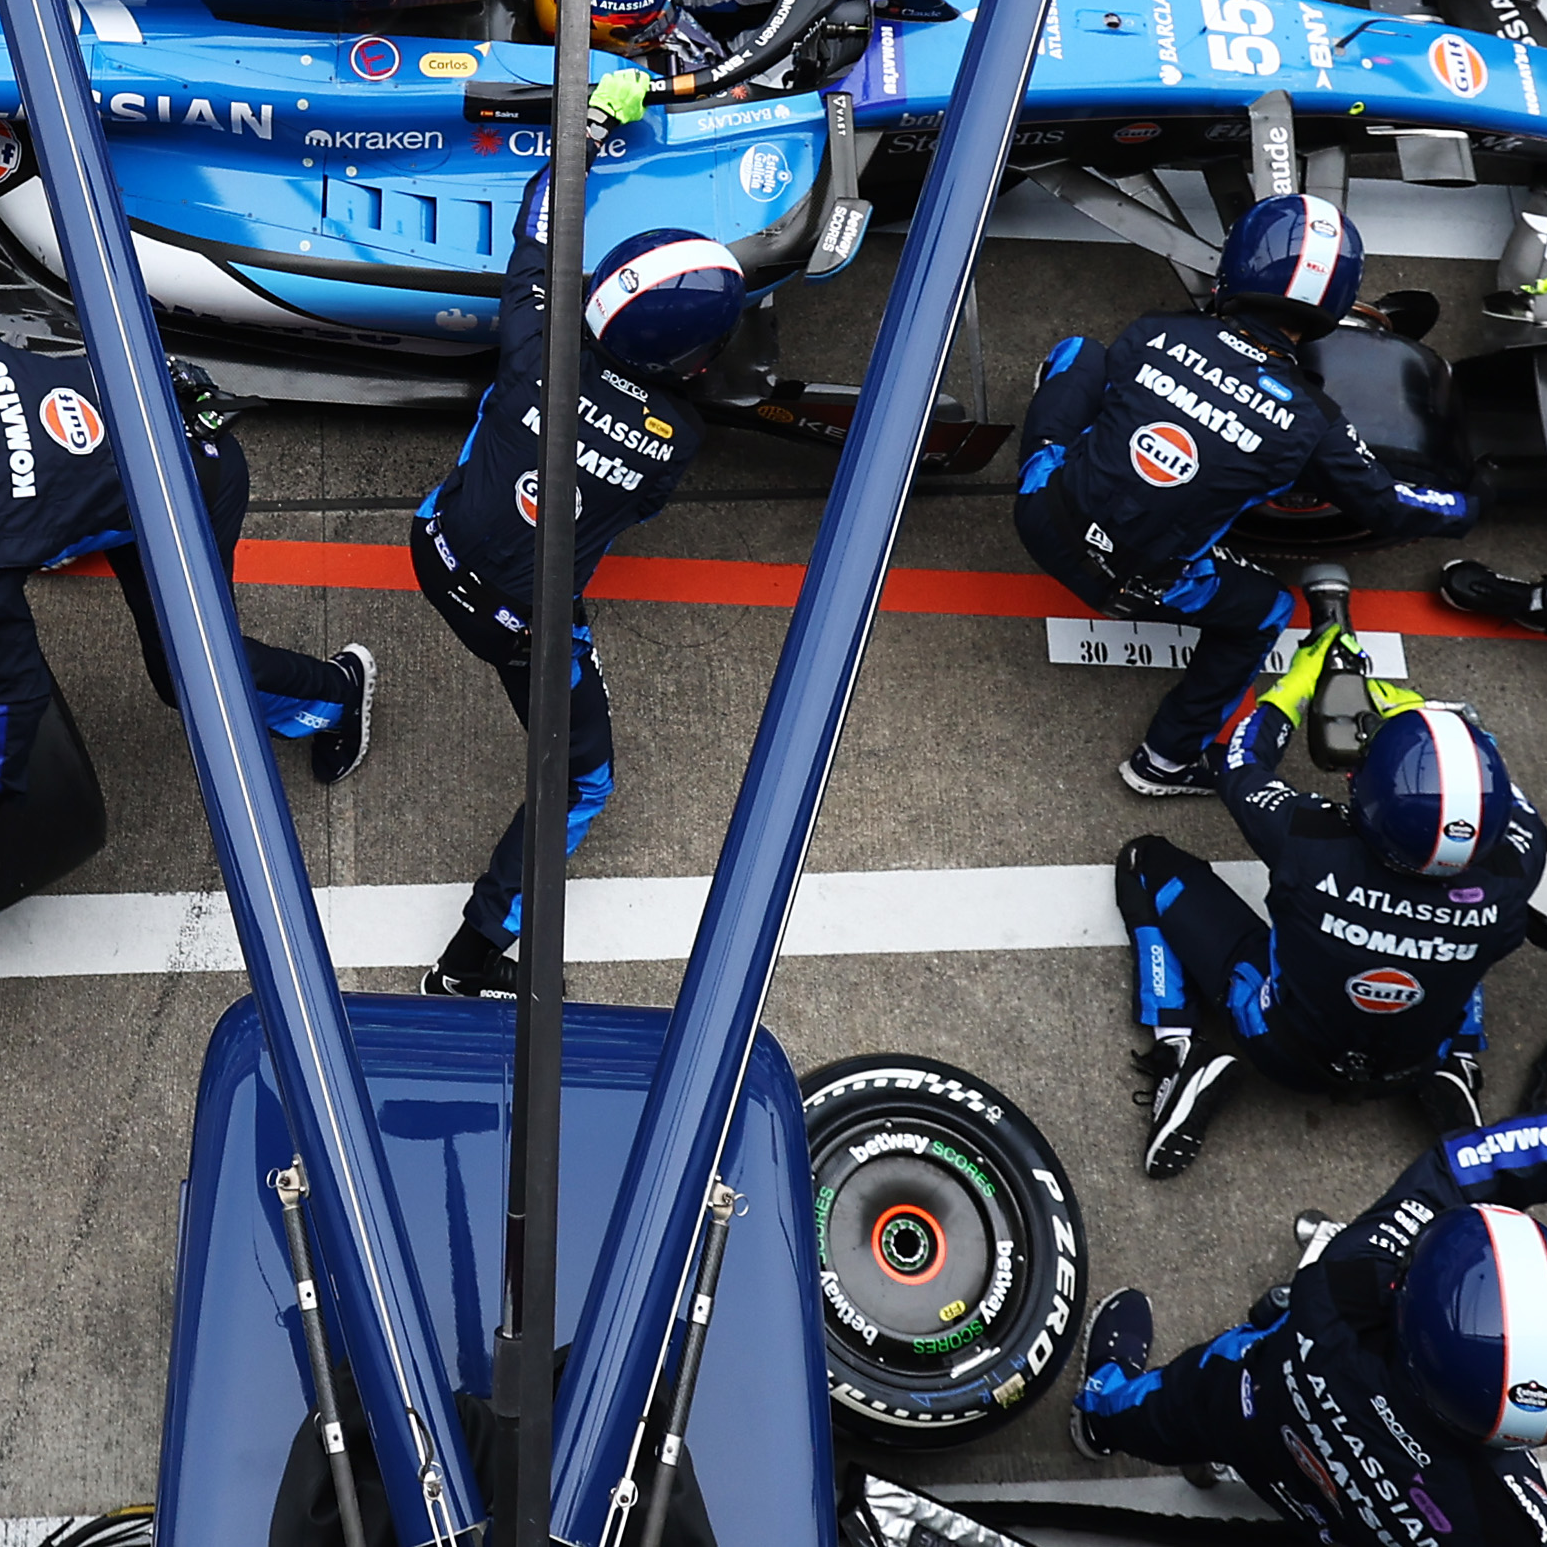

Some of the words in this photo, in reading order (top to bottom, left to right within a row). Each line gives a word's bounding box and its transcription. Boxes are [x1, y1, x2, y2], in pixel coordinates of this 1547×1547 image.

[755, 0, 792, 47] kraken
[1300, 3, 1336, 70] BNY
[428, 58, 469, 71] Carlos
[711, 53, 745, 82] BNY
[880, 25, 899, 95] KOMATSU
[1452, 39, 1472, 94] Gulf
[1513, 42, 1540, 116] KOMATSU
[334, 125, 443, 152] kraken
[494, 110, 520, 119] Sainz
[697, 107, 774, 131] BARCLAYS
[835, 108, 847, 136] VAST
[751, 152, 767, 190] Galicia
[762, 152, 780, 194] Estrella
[822, 204, 848, 254] SCORES
[834, 209, 864, 259] betway
[1303, 261, 1330, 276] BELL
[1216, 329, 1268, 363] sparco
[600, 368, 649, 403] sparco
[1134, 362, 1262, 453] KOMATSU
[1166, 342, 1295, 431] ATLASSIAN
[56, 391, 90, 449] Gulf
[577, 395, 675, 463] TLASSIAN
[1136, 431, 1193, 481] Gulf
[1080, 639, 1108, 664] 30
[1124, 641, 1153, 667] 20
[1169, 642, 1195, 668] 10
[1347, 885, 1499, 929] ATLASSIAN
[1320, 911, 1479, 963] KOMATSU
[1151, 944, 1165, 998] sparco
[1350, 979, 1421, 1007] Gulf
[848, 1130, 931, 1164] betway
[931, 1140, 997, 1200] SCORES
[1031, 1167, 1065, 1203] P
[817, 1270, 880, 1345] betway
[983, 1240, 1015, 1327] betway
[1026, 1217, 1080, 1377] ZERO
[913, 1319, 986, 1355] SCORES
[1369, 1393, 1432, 1469] sparco
